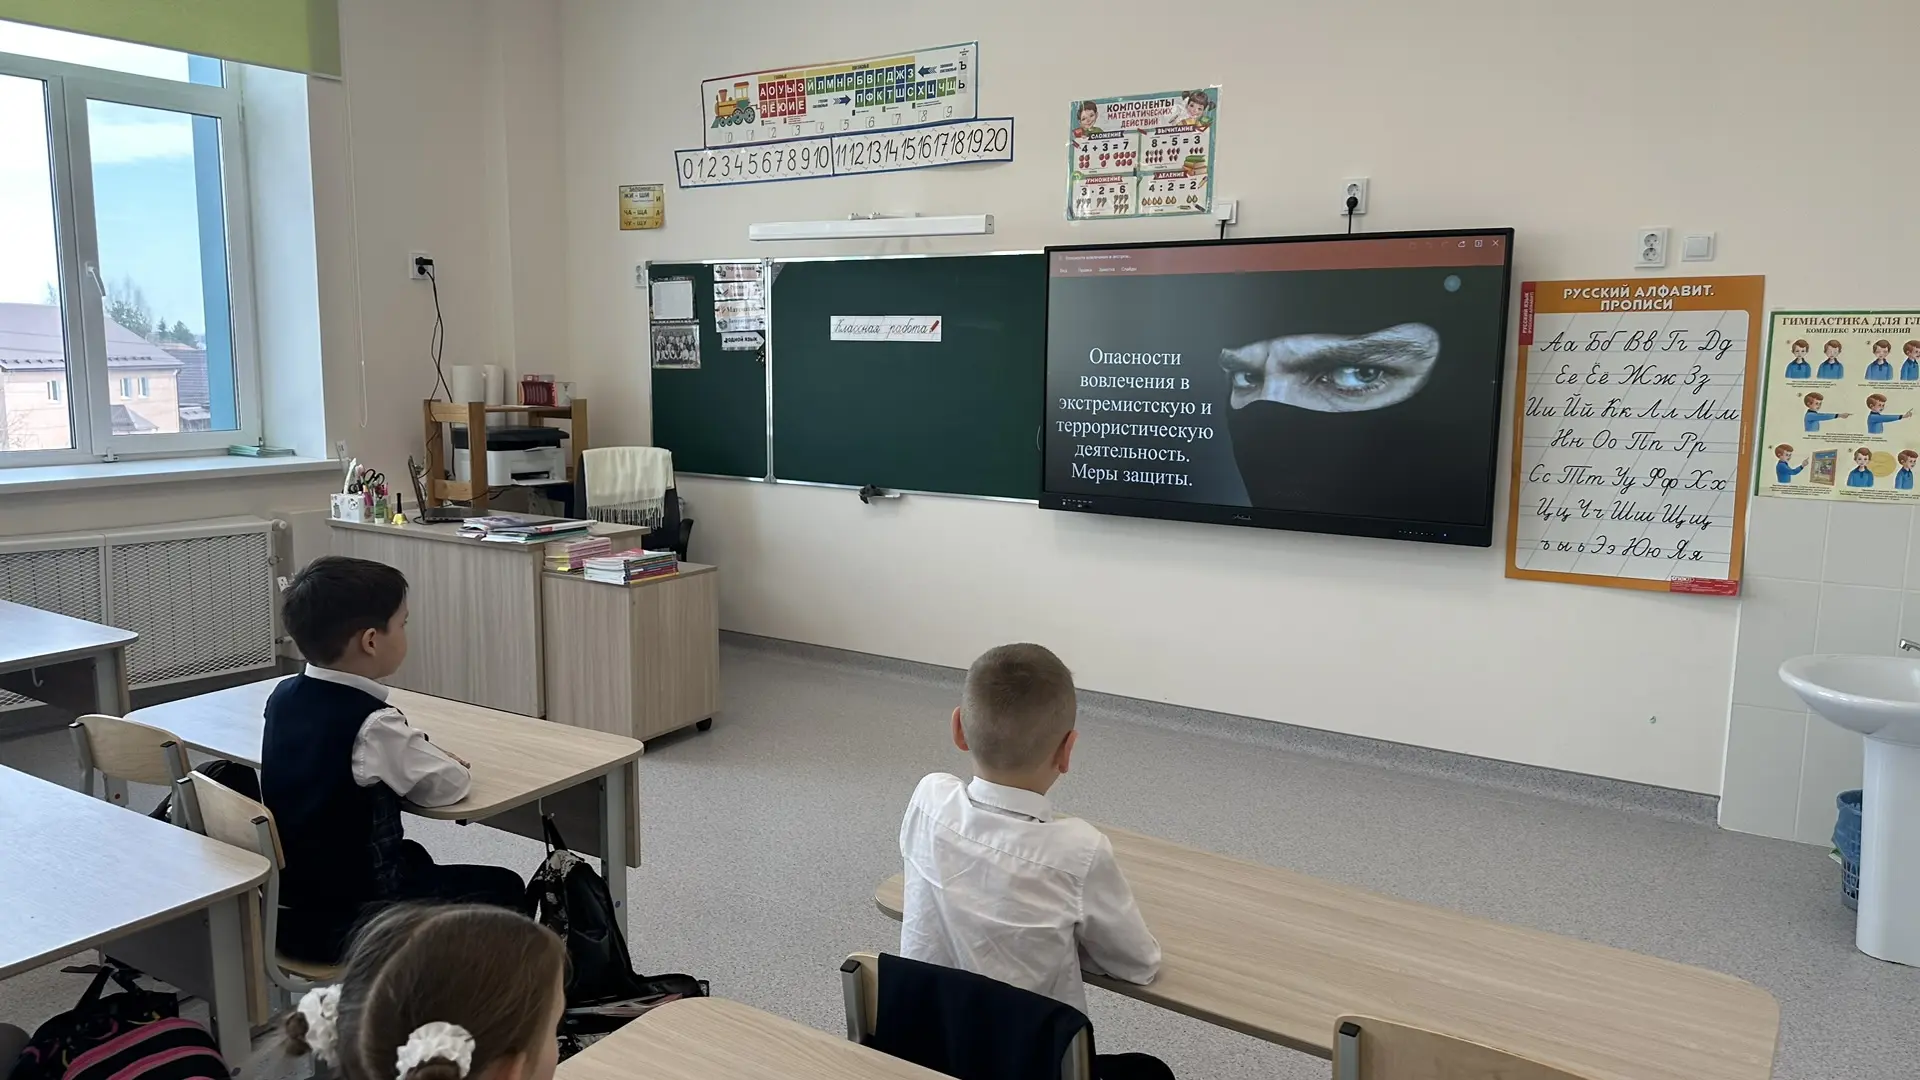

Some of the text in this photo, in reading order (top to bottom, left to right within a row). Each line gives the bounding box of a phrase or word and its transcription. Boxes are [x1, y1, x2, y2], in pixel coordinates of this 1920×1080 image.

[1106, 99, 1174, 112] КОМПОНЕНТЫ
[1108, 107, 1173, 120] МАТЕМАТИЧЕСКИХ
[1091, 131, 1122, 139] СЛОЖЕНИЕ
[1158, 126, 1194, 134] ВЫЧИТАНИЕ
[835, 127, 1008, 167] 11 12 13 14 15 16 17 18 19 20
[683, 145, 829, 179] 0 1 2 3 4 5 6 7 8 9 10
[1563, 285, 1715, 299] РУССКИЙ АЛФАВИТ.
[1600, 299, 1673, 311] ПРОПИСИ
[834, 317, 928, 339] Классная работа
[1782, 317, 1870, 326] ГИМНАСТИКА
[1873, 317, 1900, 327] ДЛЯ
[1540, 331, 1578, 351] Аа
[1585, 330, 1627, 351] Бб
[1623, 330, 1658, 351] Вв
[1661, 329, 1688, 351] Гг
[1089, 347, 1181, 365] Опасности
[1080, 375, 1190, 390] вовлечения в
[1555, 362, 1711, 395] Ее Ёё Жж Зз
[1059, 397, 1212, 418] экстремистскую и
[1526, 393, 1739, 421] Ии Йй Кк Лл Мм
[1056, 420, 1214, 443] террористическую
[1074, 444, 1190, 462] деятельность.
[1550, 428, 1707, 459] Нн Оо Пп Рр
[1072, 462, 1193, 487] Меры защиты.
[1528, 464, 1727, 496] Сс Тт Уу Фф Хх
[1536, 497, 1712, 531] Цц Чч Шш Щщ
[1540, 535, 1703, 561] ъ ы ь Ээ Юю Яя
